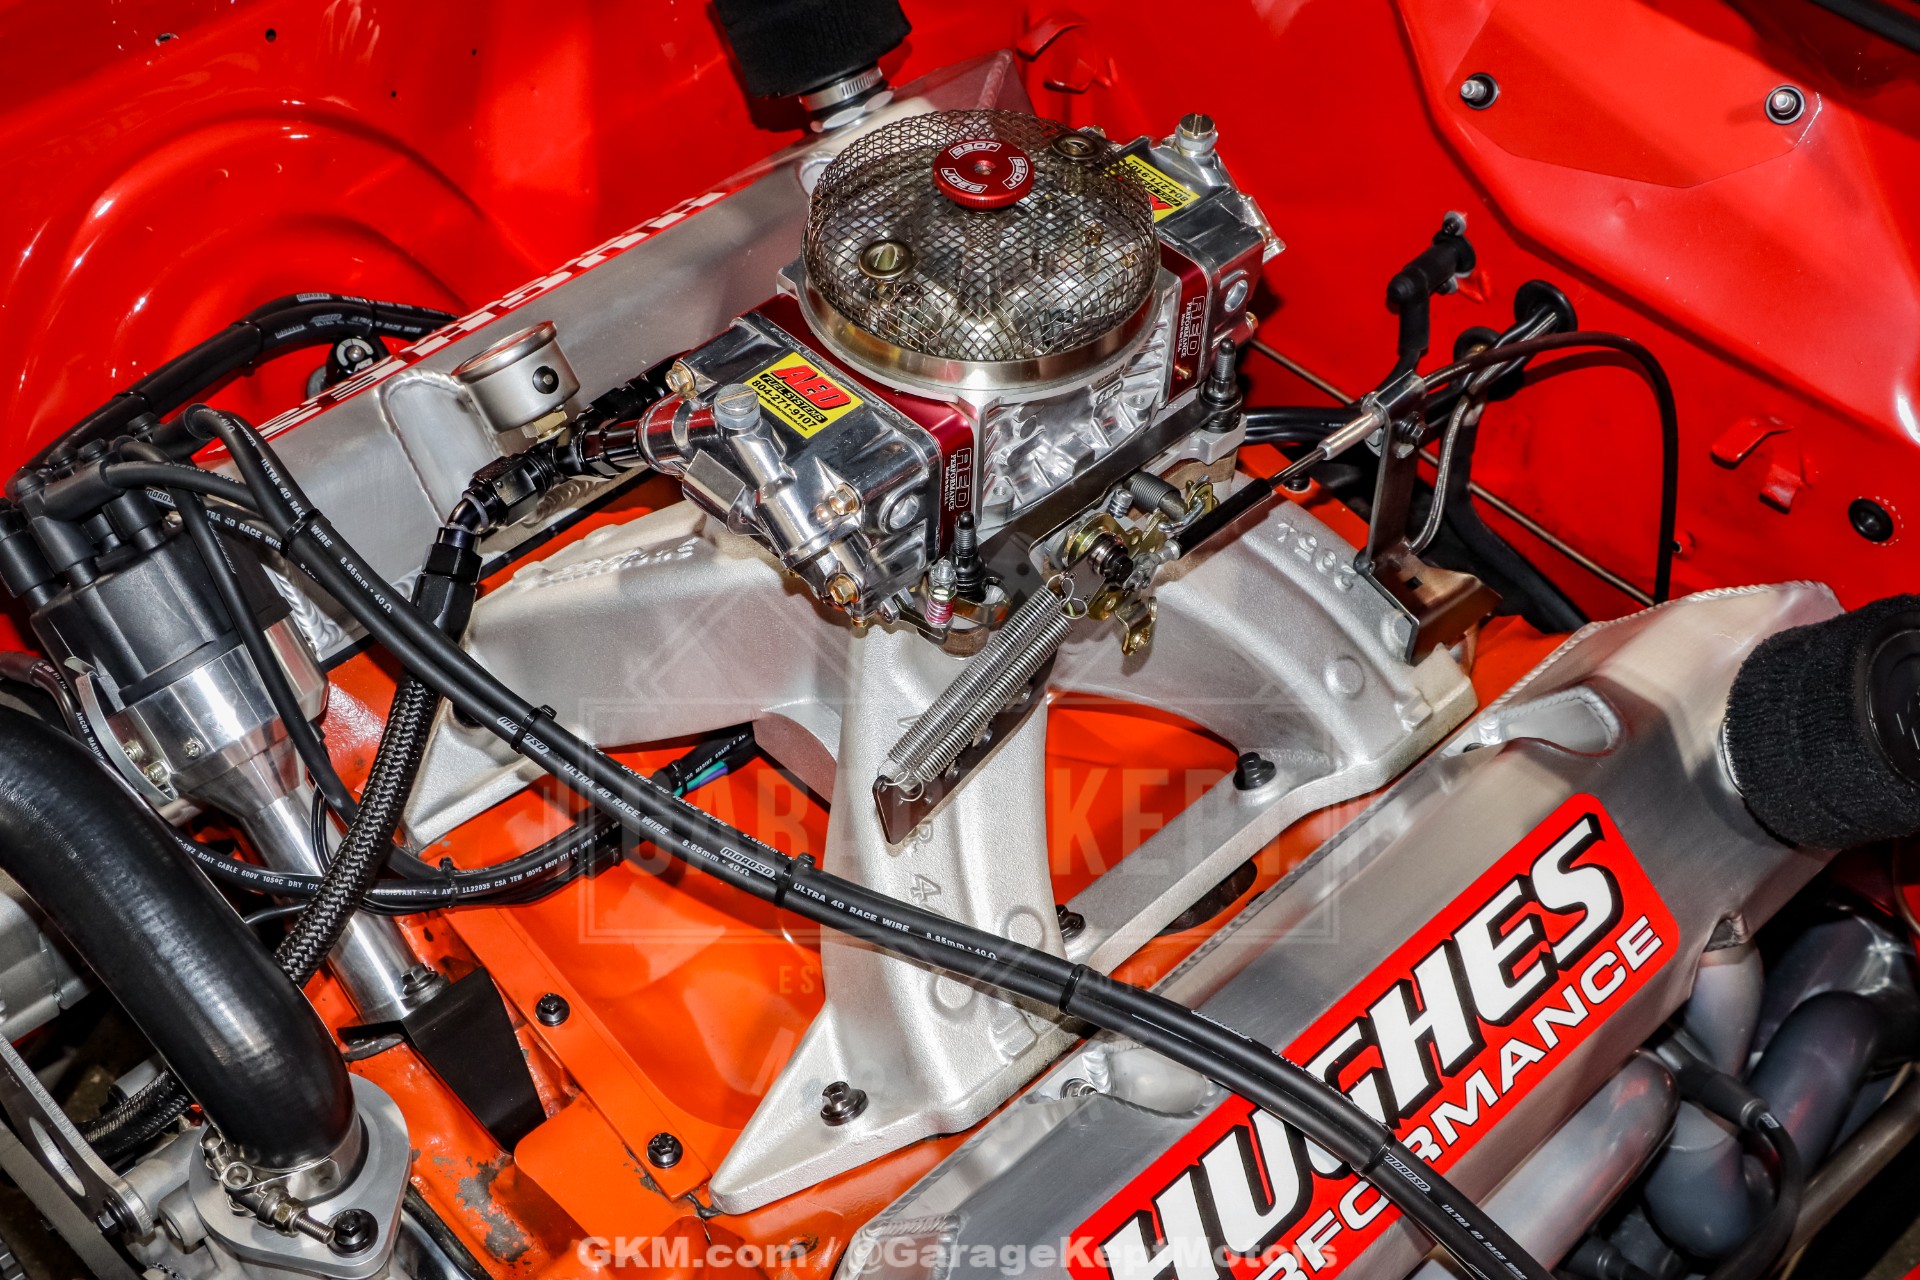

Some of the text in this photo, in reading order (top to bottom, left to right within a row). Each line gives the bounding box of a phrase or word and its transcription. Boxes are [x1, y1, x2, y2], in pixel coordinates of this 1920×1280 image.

[949, 141, 1001, 159] JOES
[1004, 157, 1028, 189] JOES
[941, 168, 987, 193] JOES
[751, 380, 818, 428] 804-271-9107
[761, 374, 825, 421] FUEL SYSTEMS
[770, 364, 851, 410] AED
[146, 486, 177, 508] MOROS
[206, 510, 221, 522] TRA
[239, 522, 262, 539] RACE
[265, 535, 282, 550] WIR
[280, 487, 291, 499] 40
[289, 500, 306, 519] RAC
[310, 524, 334, 548] WIRE
[497, 717, 550, 756] MOOSO
[563, 763, 595, 788] ULTRA
[597, 786, 611, 799] 40
[612, 796, 640, 818] RACE
[641, 816, 670, 836] WIRE
[620, 764, 652, 785] ULTRA
[702, 811, 729, 827] WIRE
[198, 852, 215, 864] BOAT
[217, 861, 238, 874] CABLE
[241, 870, 259, 880] 600V
[287, 880, 303, 889] DRY
[462, 882, 491, 894] LL22035
[494, 878, 507, 887] CSA
[509, 874, 523, 883] TEW
[793, 882, 826, 903] ULTRA
[831, 899, 845, 910] 40
[849, 906, 878, 922] RACE
[882, 917, 910, 933] WIRE
[1100, 814, 1624, 1280] HUGHES
[1441, 1204, 1470, 1228] ULTRA
[1483, 1241, 1507, 1261] RACE
